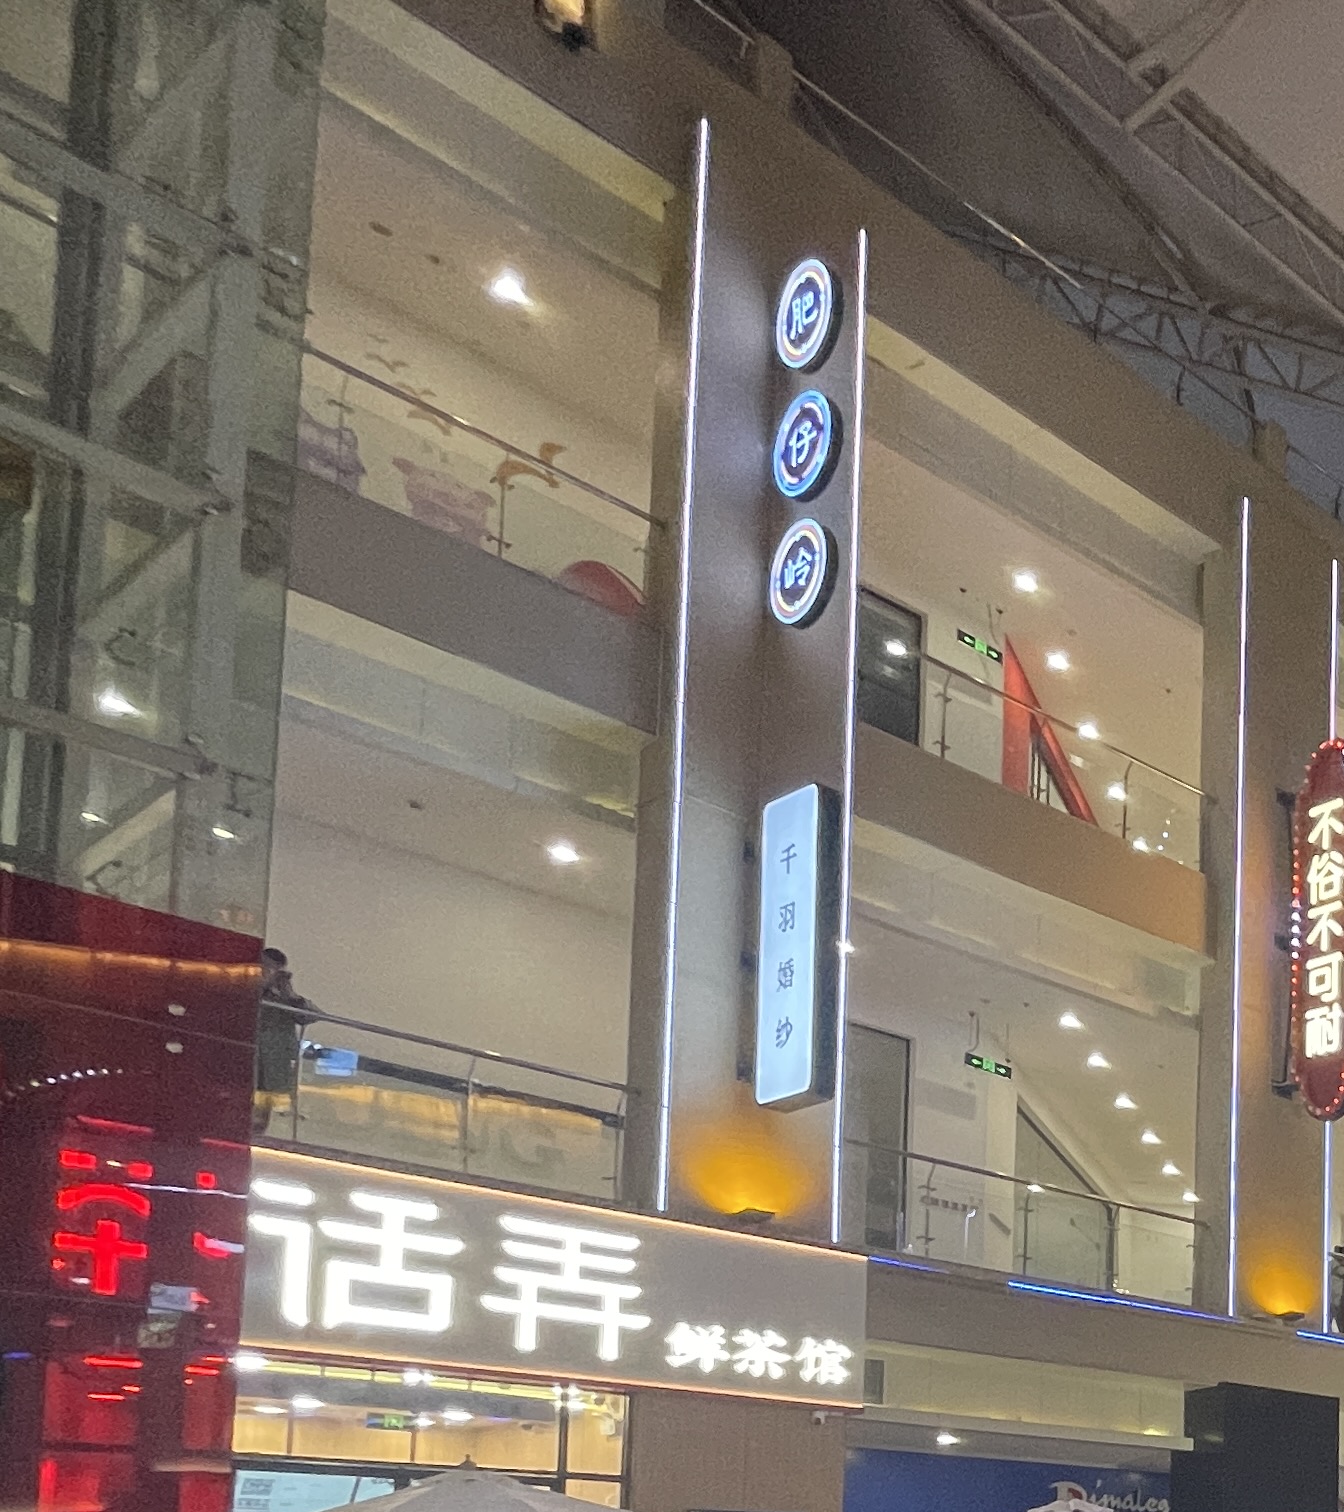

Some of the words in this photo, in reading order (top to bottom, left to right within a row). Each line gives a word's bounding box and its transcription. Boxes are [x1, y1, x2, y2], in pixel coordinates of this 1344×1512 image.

[775, 843, 797, 1048] 千羽婚纱
[664, 1320, 857, 1386] 鲜茶馆
